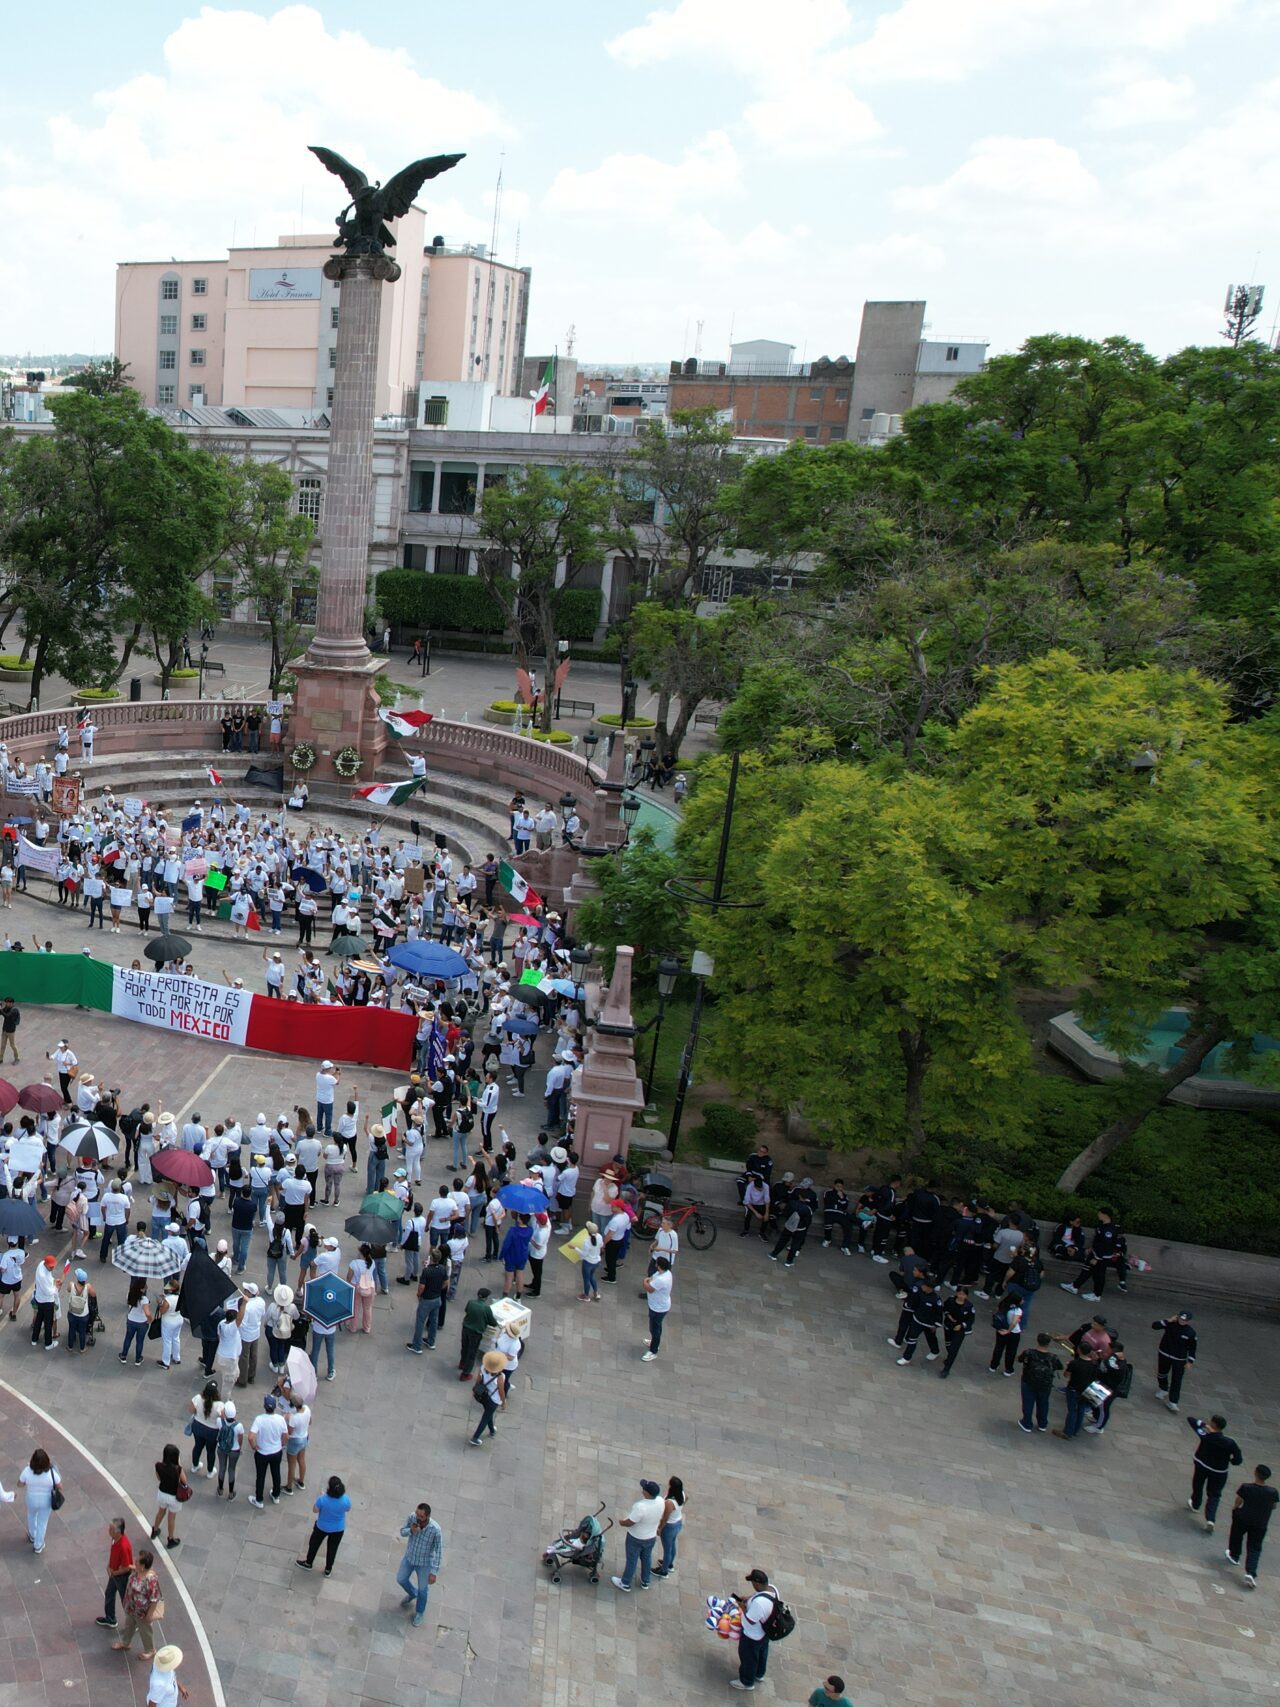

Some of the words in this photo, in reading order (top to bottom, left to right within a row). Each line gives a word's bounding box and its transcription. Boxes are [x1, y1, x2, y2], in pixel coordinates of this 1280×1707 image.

[256, 288, 280, 298] Hotel
[280, 288, 313, 298] Francia
[120, 967, 152, 986] ESTA
[157, 976, 218, 1001] PROTESTA
[224, 991, 240, 1008] ES
[124, 982, 146, 998] POR
[151, 989, 167, 1006] TI,
[170, 993, 191, 1011] POR
[213, 1005, 234, 1025] POR
[137, 1001, 166, 1020] TODO
